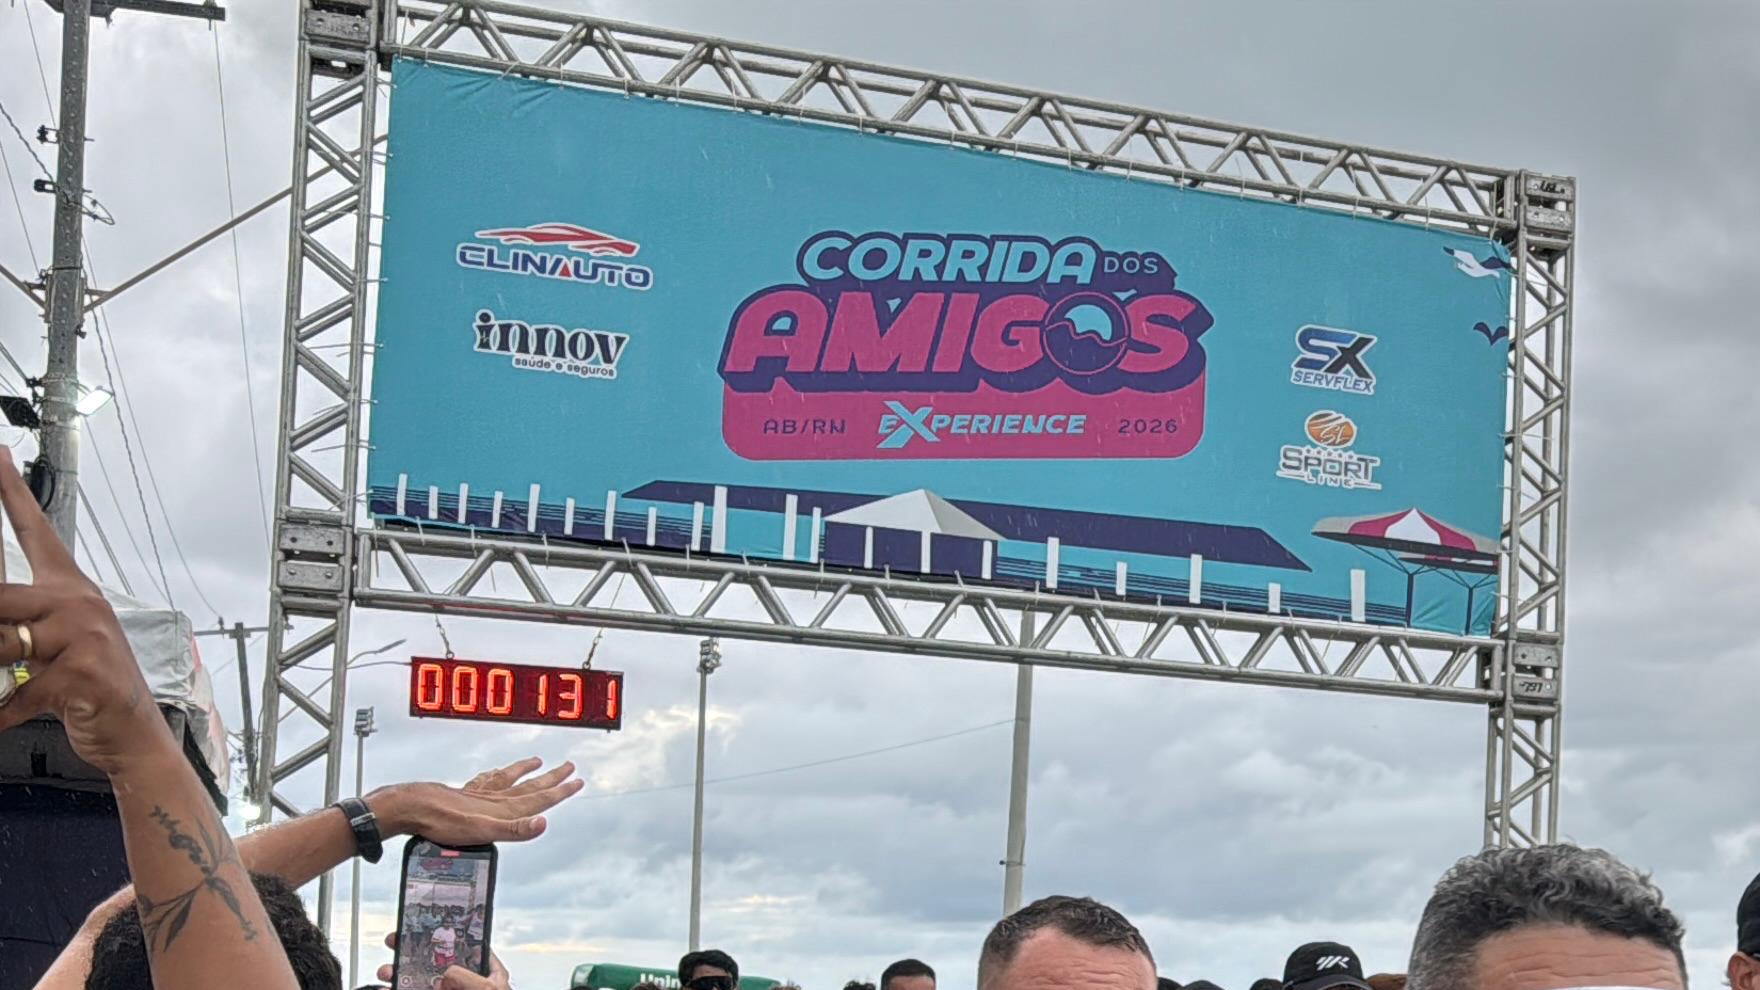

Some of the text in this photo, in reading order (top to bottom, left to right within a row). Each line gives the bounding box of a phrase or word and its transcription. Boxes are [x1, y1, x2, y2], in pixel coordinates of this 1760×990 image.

[458, 243, 653, 290] CLINAUTO
[802, 236, 1160, 285] CORRIDA DOS
[474, 311, 628, 366] innov
[724, 290, 1199, 376] AMIGOS
[1294, 326, 1377, 379] SX
[566, 363, 615, 377] seguros
[1292, 370, 1373, 394] SERVFLEX
[763, 418, 846, 435] AB/RN
[1118, 418, 1179, 435] 2026
[1282, 447, 1378, 480] SPORT
[1306, 475, 1355, 487] LINE
